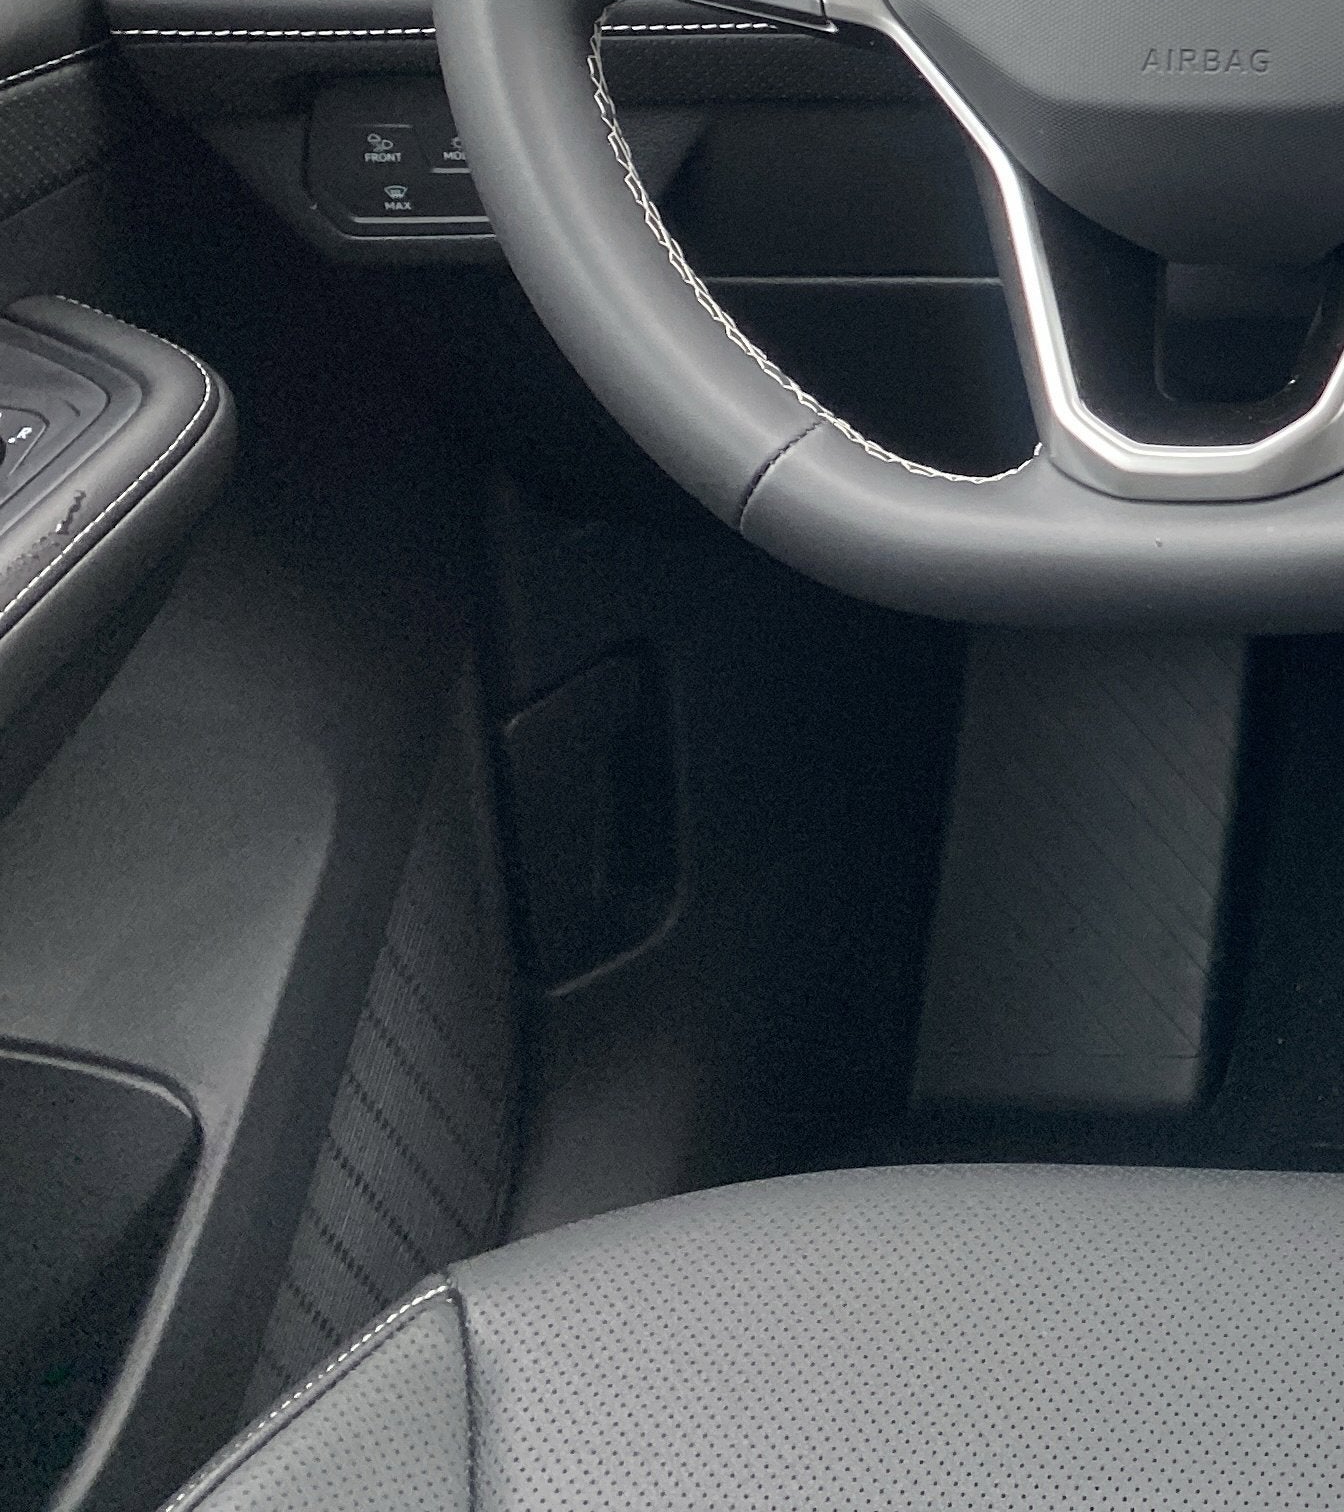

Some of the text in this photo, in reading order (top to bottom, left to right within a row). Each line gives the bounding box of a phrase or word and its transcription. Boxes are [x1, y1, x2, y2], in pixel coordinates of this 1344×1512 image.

[1141, 48, 1272, 75] AIRBAG
[364, 152, 402, 163] FRONT
[443, 150, 466, 161] MO
[384, 201, 412, 210] MAX
